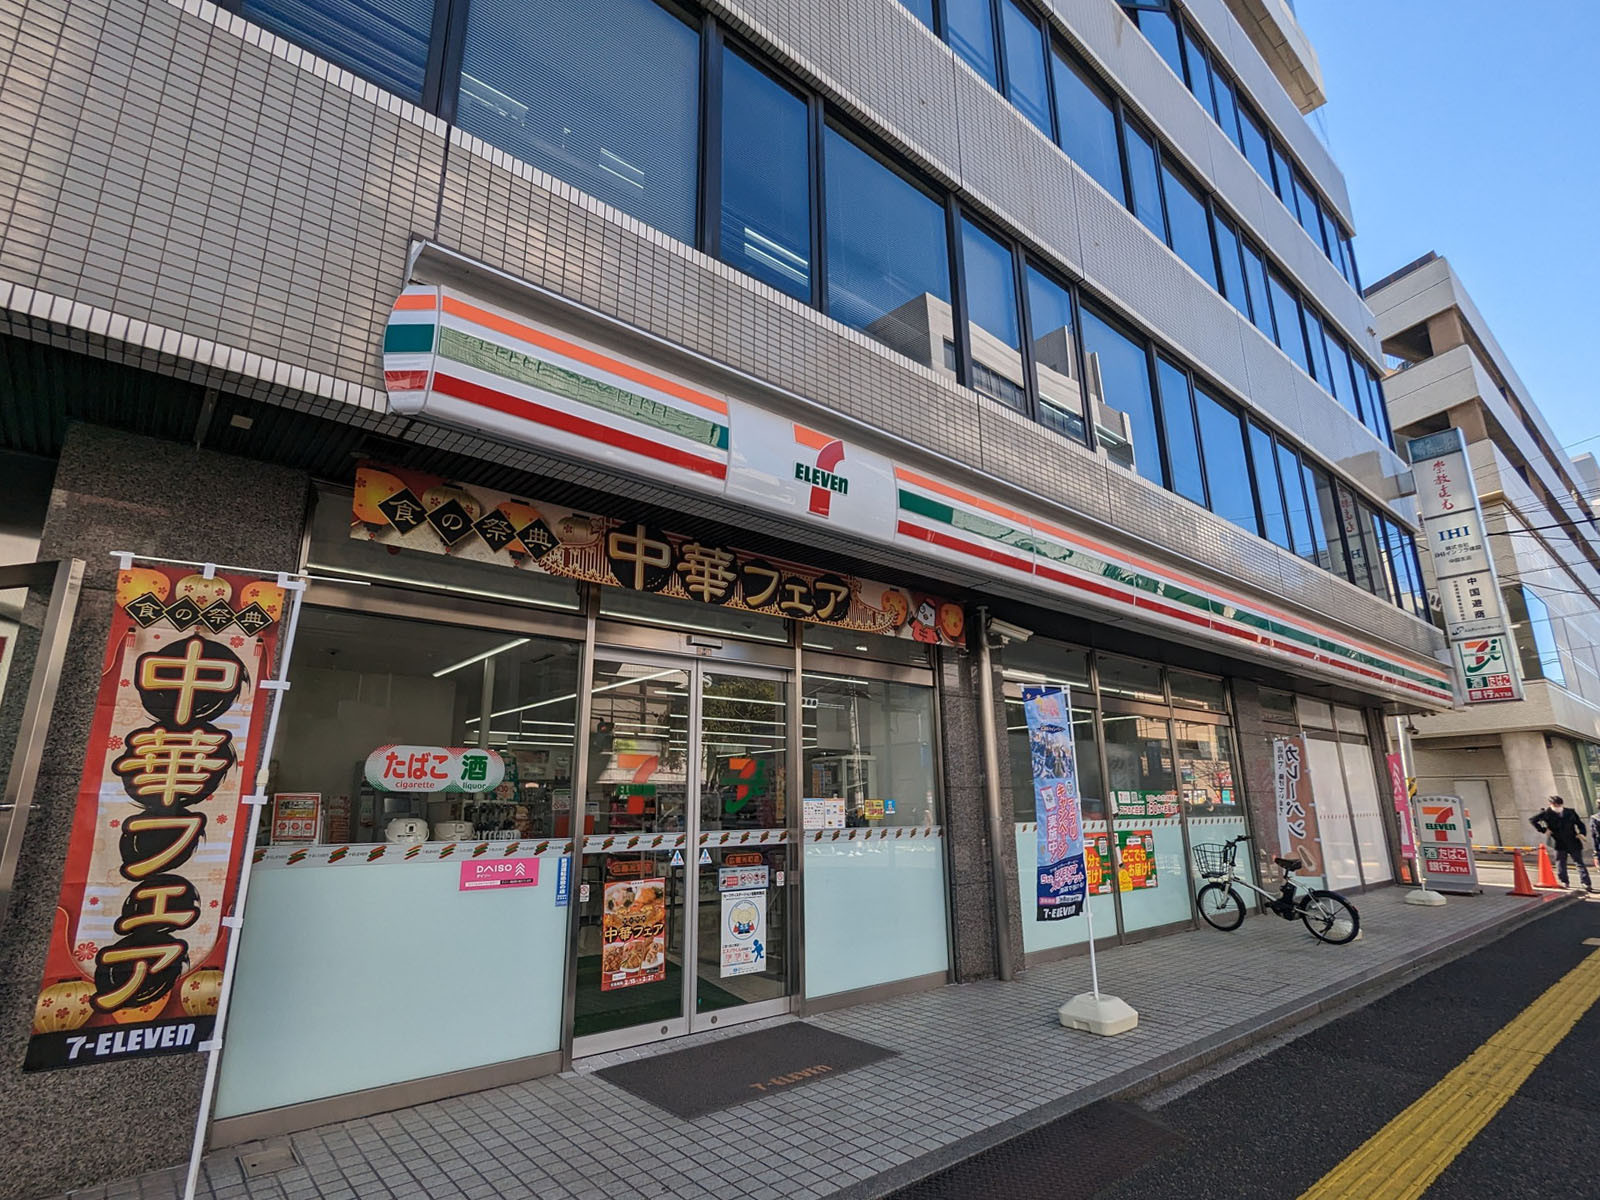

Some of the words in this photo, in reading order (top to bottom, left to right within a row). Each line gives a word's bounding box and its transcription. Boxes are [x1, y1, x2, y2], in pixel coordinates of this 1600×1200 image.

[393, 499, 551, 549] 食の祭典
[1438, 526, 1471, 541] IHI
[608, 523, 850, 620] 中華フェア
[1467, 577, 1485, 619] 中国遊商
[134, 602, 264, 627] 食の祭典
[383, 751, 449, 780] たばこ
[461, 754, 488, 781] 酒
[395, 781, 435, 790] cigarette
[462, 782, 487, 790] liquor
[96, 640, 238, 1010] 中華フェア
[1122, 849, 1146, 862] どこでも
[1438, 848, 1467, 860] たばこ
[476, 863, 512, 873] DAISO
[1128, 862, 1151, 876] お届け!
[604, 923, 664, 943] 中華フェア
